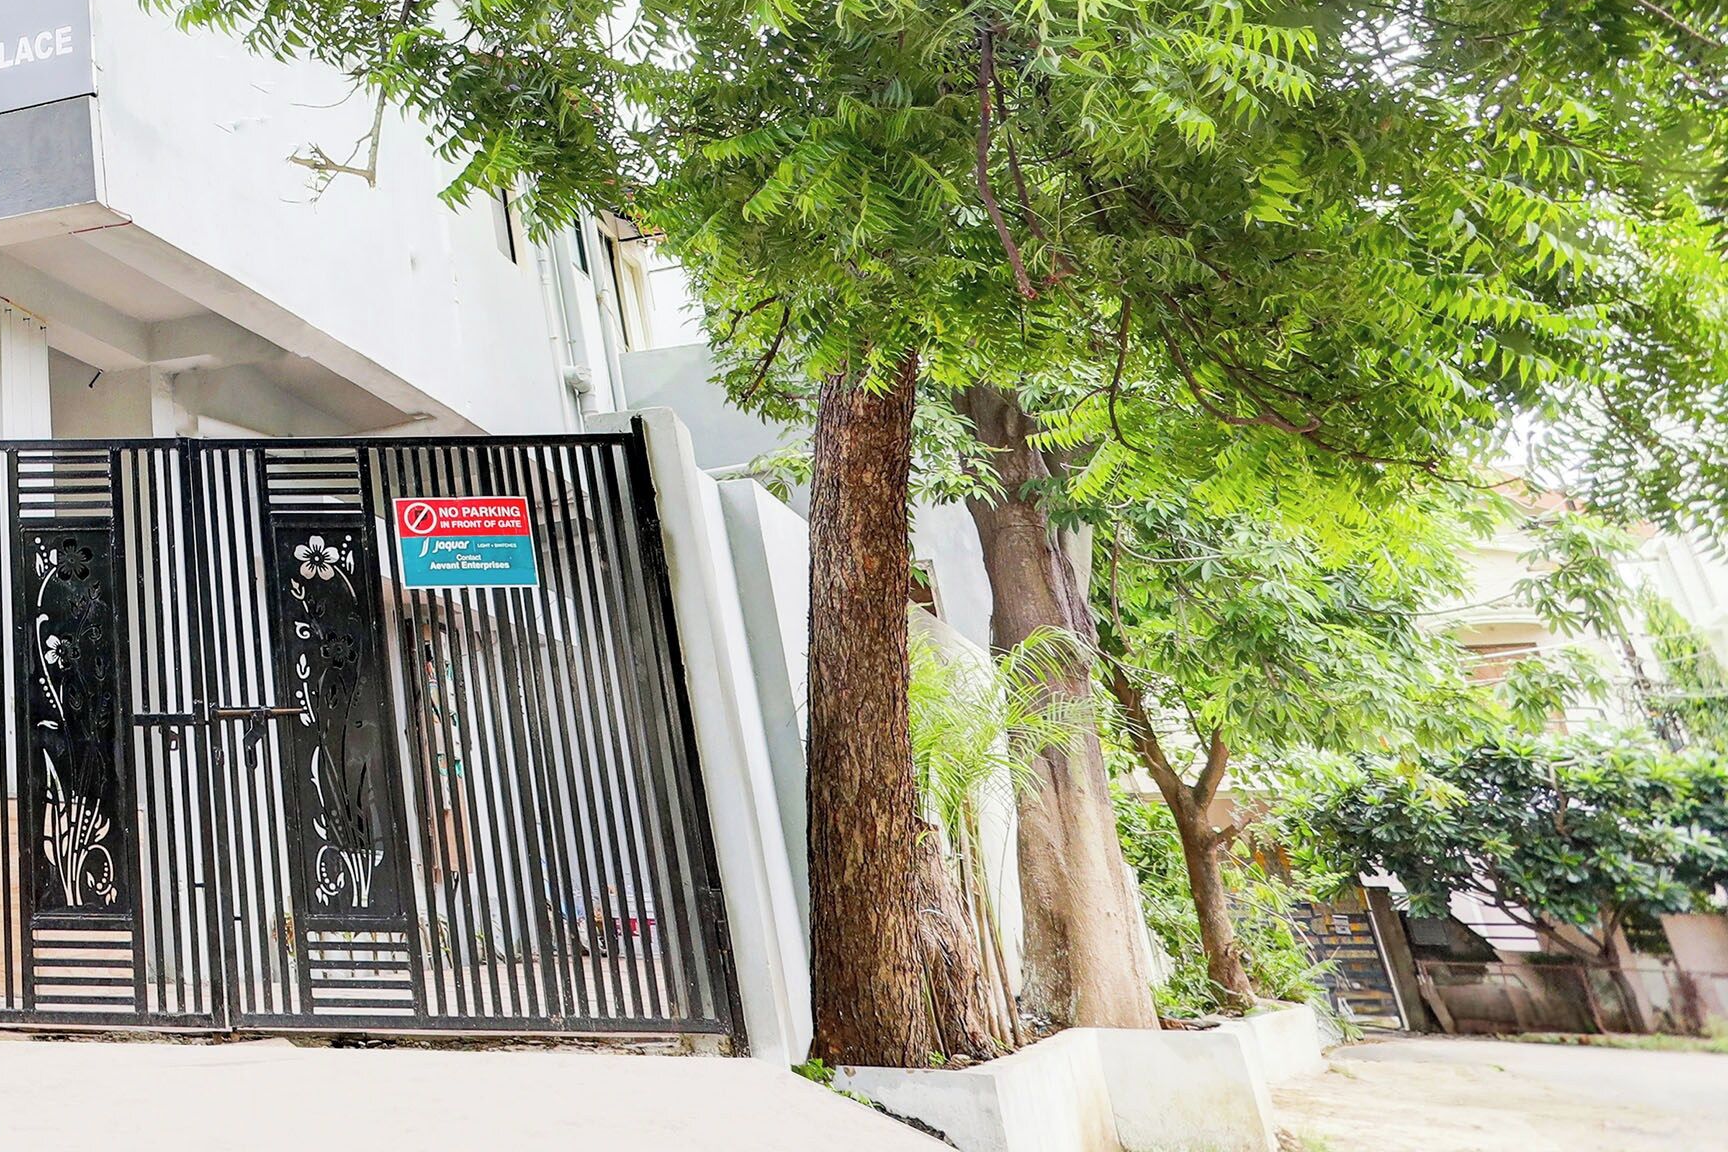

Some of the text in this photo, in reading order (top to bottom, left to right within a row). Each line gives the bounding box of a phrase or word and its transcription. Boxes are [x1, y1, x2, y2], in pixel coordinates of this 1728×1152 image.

[438, 506, 521, 518] NO PARKING
[440, 520, 522, 529] IN FRONT OF GATE
[461, 560, 510, 571] Enterprises
